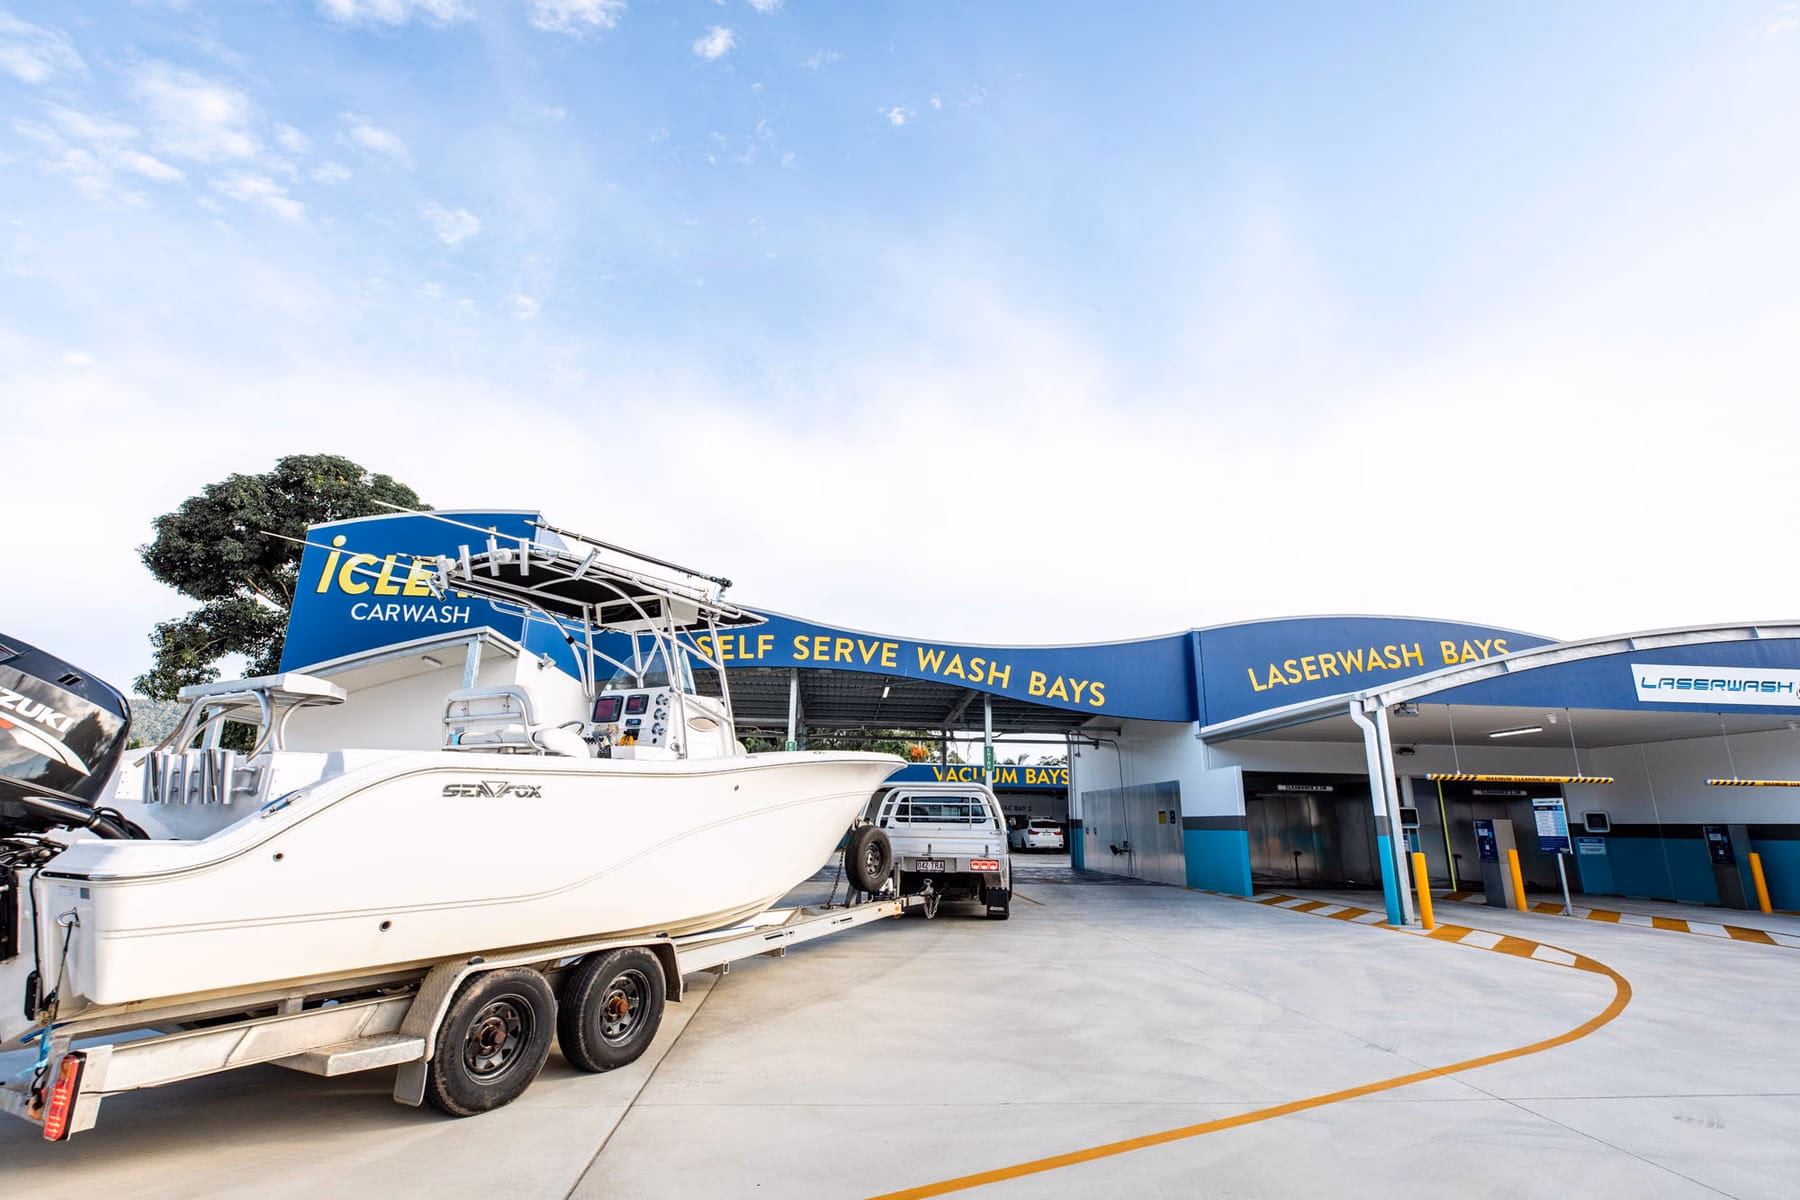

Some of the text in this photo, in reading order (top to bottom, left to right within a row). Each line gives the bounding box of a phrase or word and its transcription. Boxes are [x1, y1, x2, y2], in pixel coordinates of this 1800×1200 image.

[316, 534, 480, 598] iCLE
[351, 602, 470, 624] CARWASH
[696, 635, 1105, 707] SELF SERVE WASH BAYS
[1248, 639, 1510, 692] LASERWASH BAYS
[1641, 676, 1792, 693] LASERWASH
[1025, 768, 1069, 785] BAYS
